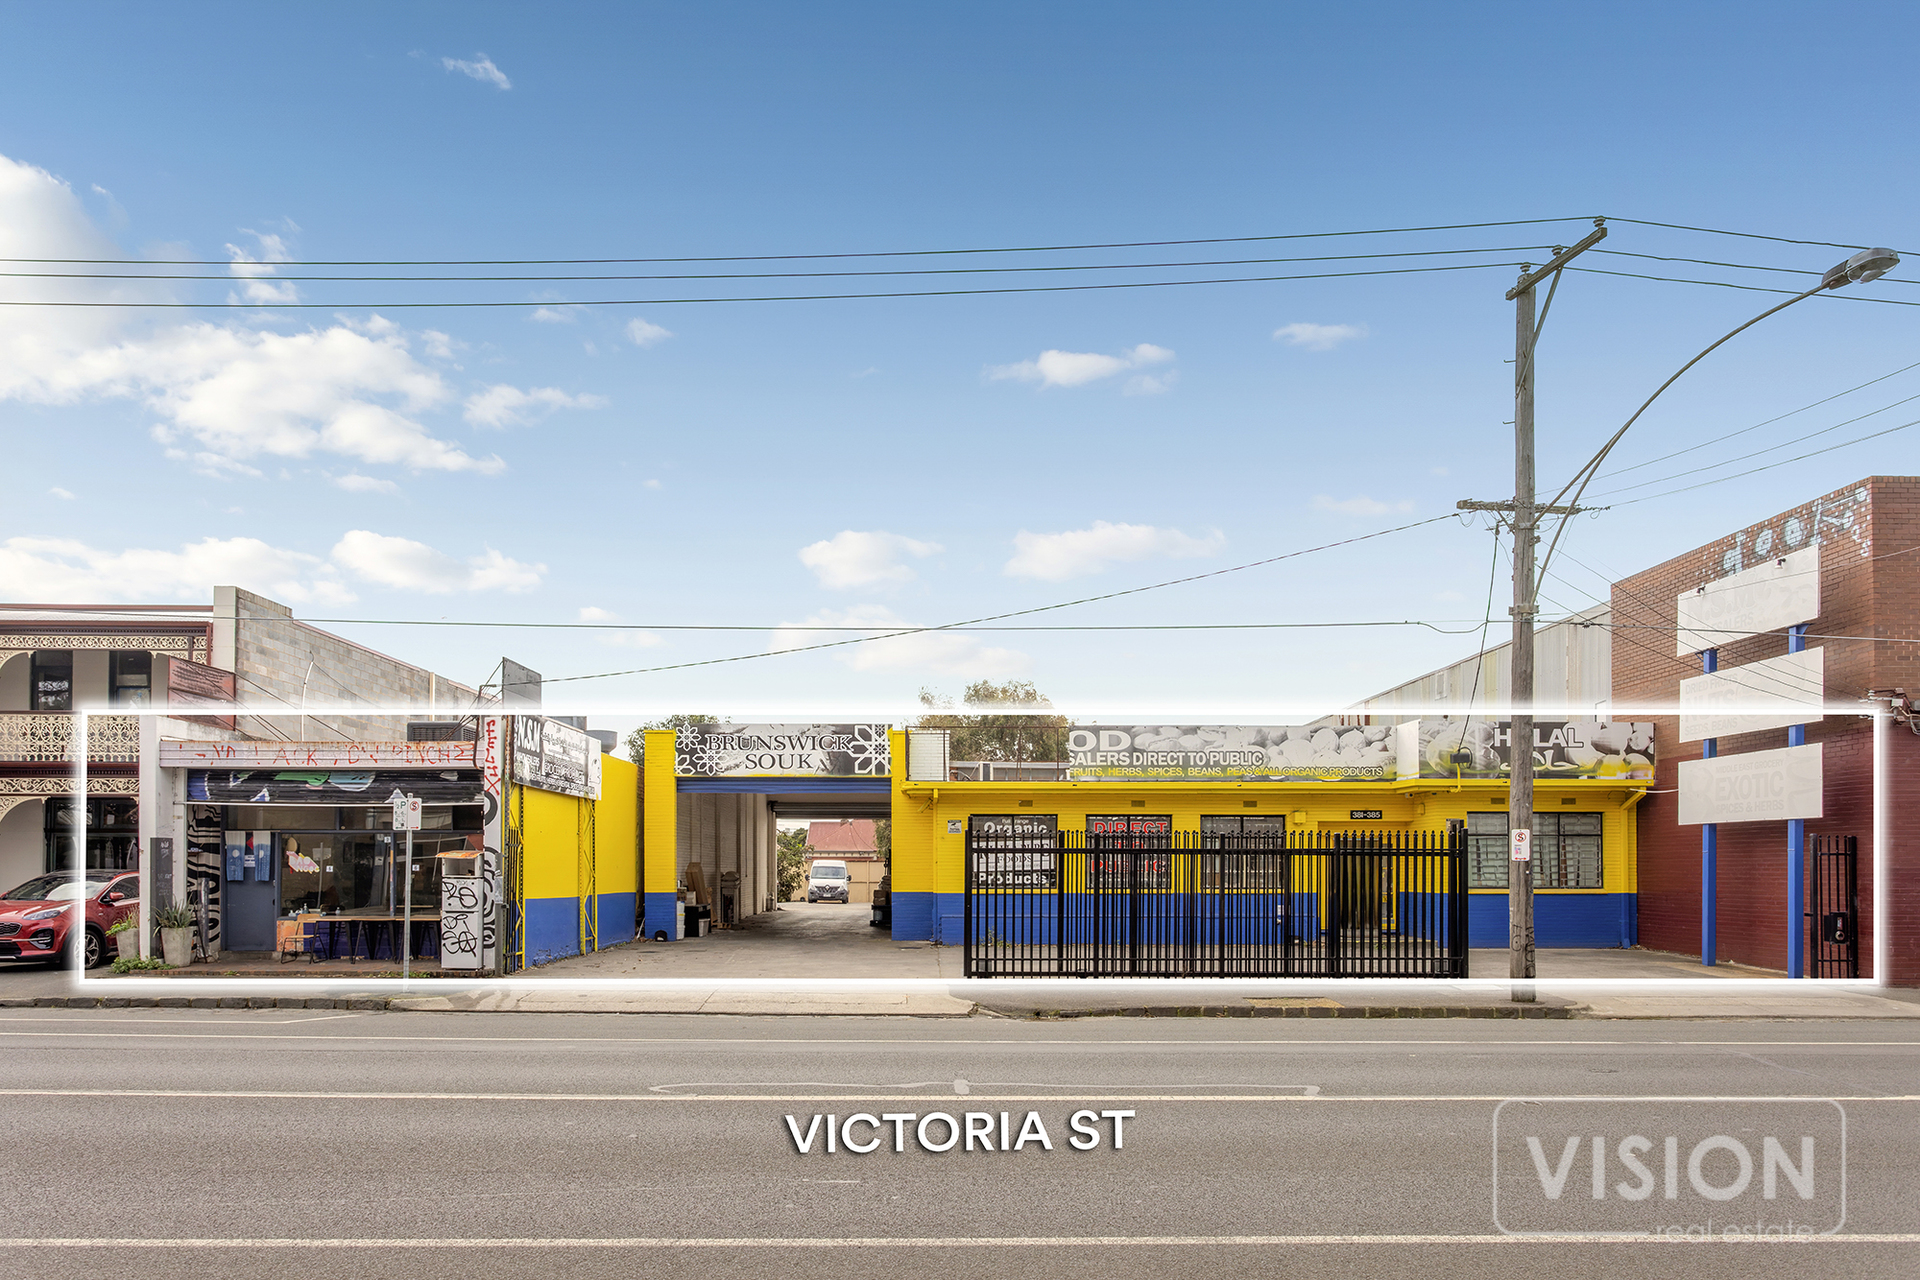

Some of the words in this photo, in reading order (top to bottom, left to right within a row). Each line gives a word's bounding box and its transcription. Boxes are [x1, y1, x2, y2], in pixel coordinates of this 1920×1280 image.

[1711, 717, 1738, 731] BEANS
[705, 735, 855, 752] BRUNSWICK
[1494, 728, 1583, 747] HLAL
[744, 753, 813, 770] SOUK
[1133, 752, 1185, 766] DIRECT
[1187, 752, 1207, 766] TO
[1209, 752, 1264, 766] PUBLIC
[1715, 763, 1738, 774] MIDDLE
[1739, 761, 1754, 772] EAST
[1754, 758, 1785, 770] GROCERY
[1108, 768, 1145, 779] HERBS,
[1147, 768, 1185, 779] SPICES,
[1188, 768, 1224, 779] BEANS,
[1227, 767, 1253, 777] PEAS
[1264, 767, 1283, 777] ALL
[1283, 767, 1328, 777] ORGANIC
[1328, 767, 1383, 777] PRODUCTS
[1715, 770, 1785, 801] EXOTIC
[1352, 811, 1381, 819] 381-385
[1715, 801, 1744, 815] SPICES
[1754, 799, 1785, 812] HERBS
[984, 821, 1048, 837] Organic
[1094, 822, 1167, 835] DIRECT
[978, 872, 1047, 884] Products
